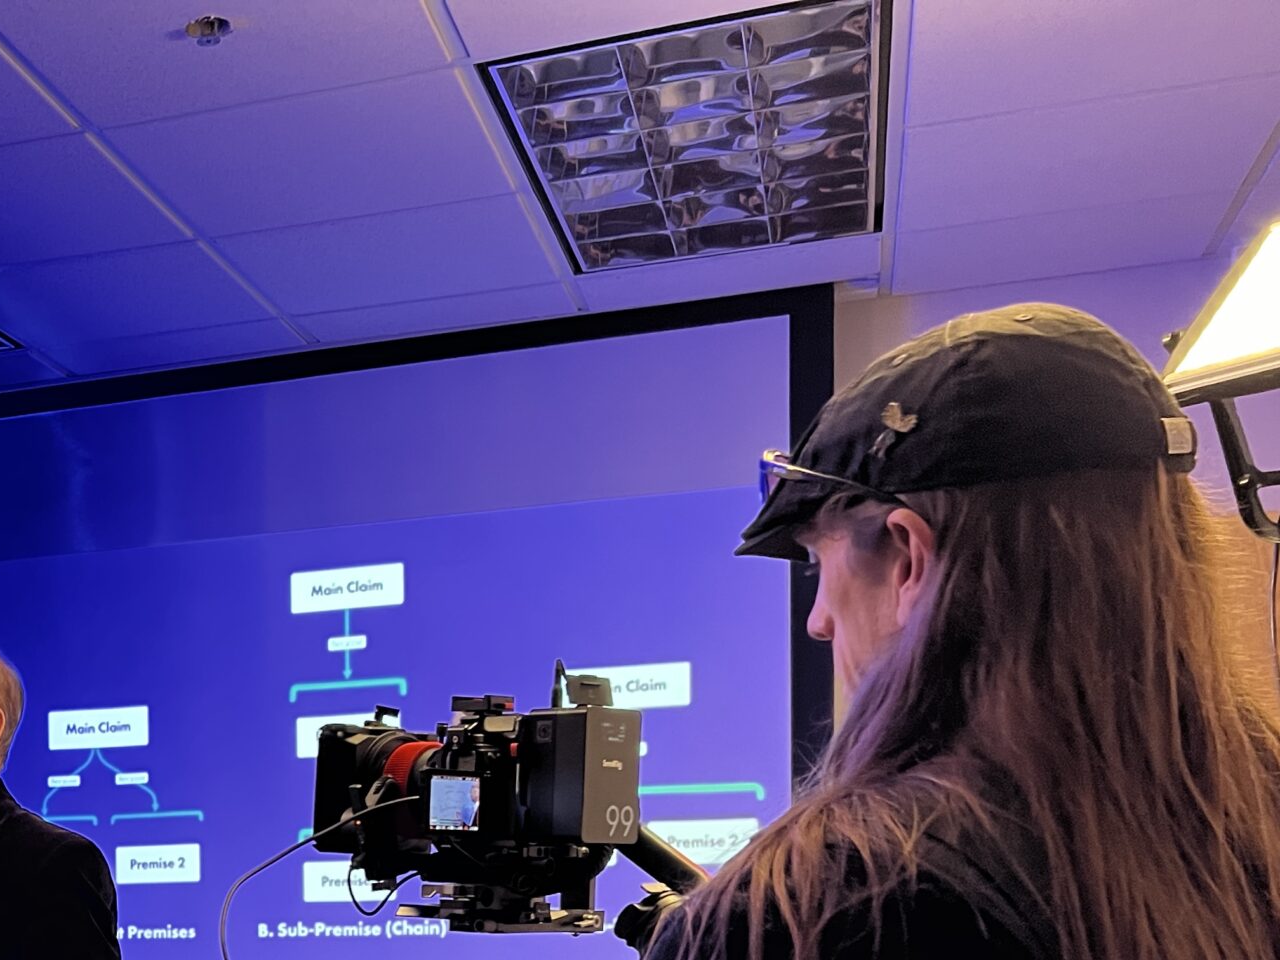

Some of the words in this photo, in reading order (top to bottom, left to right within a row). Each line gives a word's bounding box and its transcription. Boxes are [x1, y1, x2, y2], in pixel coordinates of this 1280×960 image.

[311, 582, 343, 597] Main
[346, 579, 384, 594] Claim
[625, 679, 667, 693] Claim
[66, 722, 96, 735] Main
[98, 721, 131, 734] Claim
[605, 805, 634, 837] 99
[666, 834, 726, 848] Premise
[728, 833, 739, 847] 2
[130, 857, 174, 870] Premise
[178, 856, 186, 869] 2
[127, 923, 196, 939] Premises
[258, 922, 274, 938] B.
[277, 920, 382, 938] Sub-Premise
[385, 919, 448, 939] (Chain)
